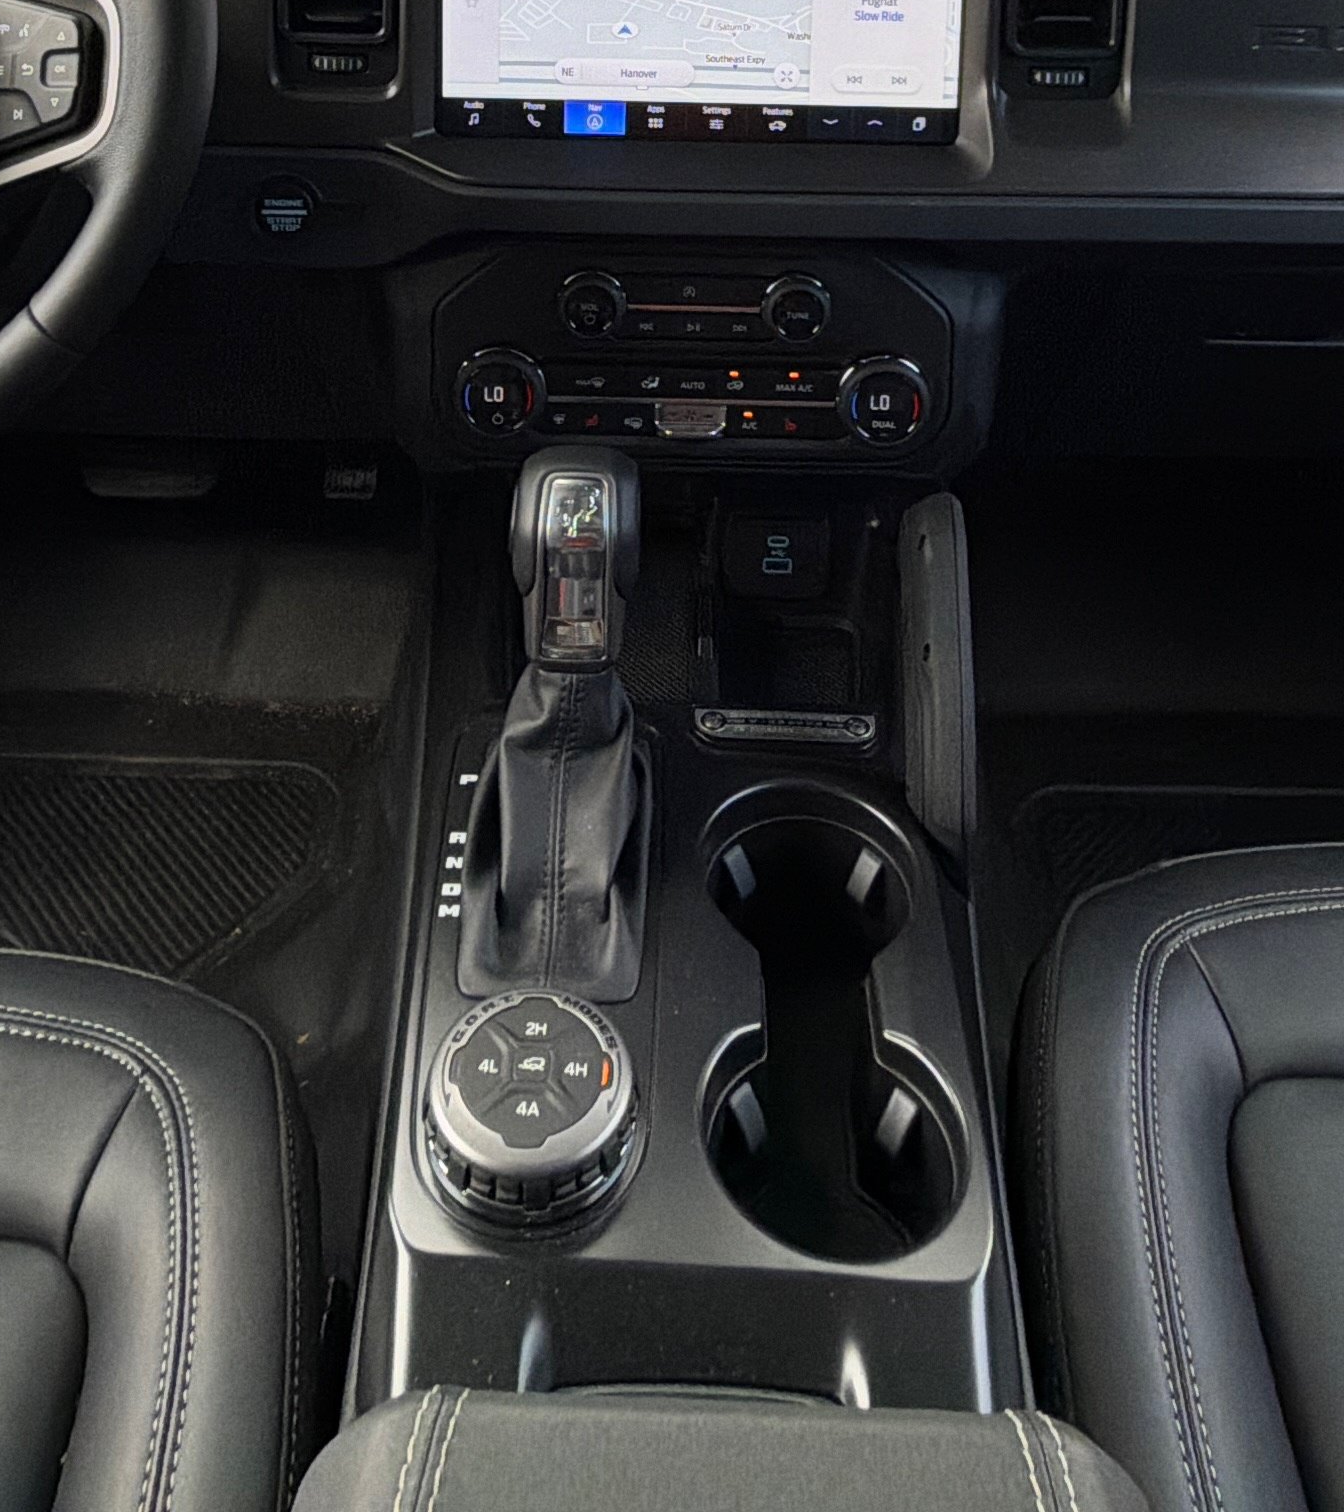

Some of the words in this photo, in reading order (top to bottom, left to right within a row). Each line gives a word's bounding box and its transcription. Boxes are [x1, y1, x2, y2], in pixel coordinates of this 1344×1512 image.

[855, 10, 879, 22] Slow
[881, 11, 905, 22] Ride
[705, 55, 745, 64] Southeast
[746, 55, 766, 66] Expy
[561, 67, 574, 77] NE
[620, 68, 658, 79] Hanover
[463, 100, 485, 110] Audio
[523, 102, 546, 111] Phone
[588, 103, 603, 112] Nav
[647, 105, 665, 115] Apps
[702, 106, 732, 116] Settings
[762, 107, 794, 116] Features
[263, 199, 305, 208] ENGINE
[680, 381, 706, 390] AUTO
[775, 384, 795, 392] MAX
[796, 384, 814, 393] A/C
[484, 386, 505, 403] LO
[870, 394, 891, 411] LO
[741, 422, 758, 430] A/C
[872, 420, 896, 429] DUAL
[459, 774, 479, 785] P
[445, 856, 464, 869] N
[441, 883, 462, 896] D
[438, 904, 461, 918] M
[562, 995, 619, 1048] MODES
[525, 1022, 547, 1036] 2H
[478, 1059, 499, 1074] 4L
[564, 1062, 588, 1078] 4H
[516, 1101, 540, 1117] 4A
